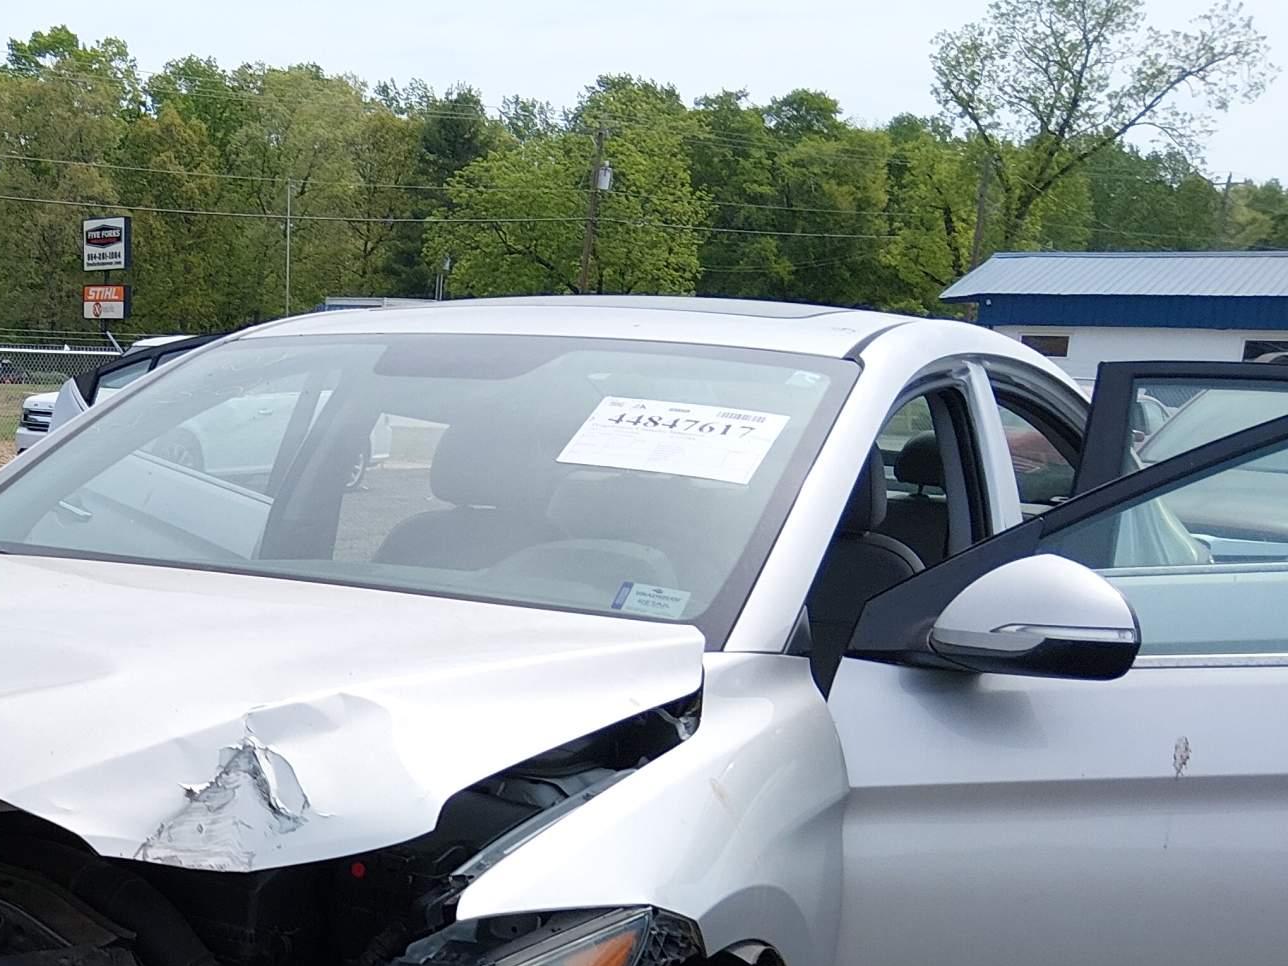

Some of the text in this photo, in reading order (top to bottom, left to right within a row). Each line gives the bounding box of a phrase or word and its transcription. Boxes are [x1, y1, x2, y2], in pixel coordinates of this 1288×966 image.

[87, 229, 120, 239] FIVE FORKS
[87, 287, 119, 300] STIHL
[608, 412, 756, 438] 44847617
